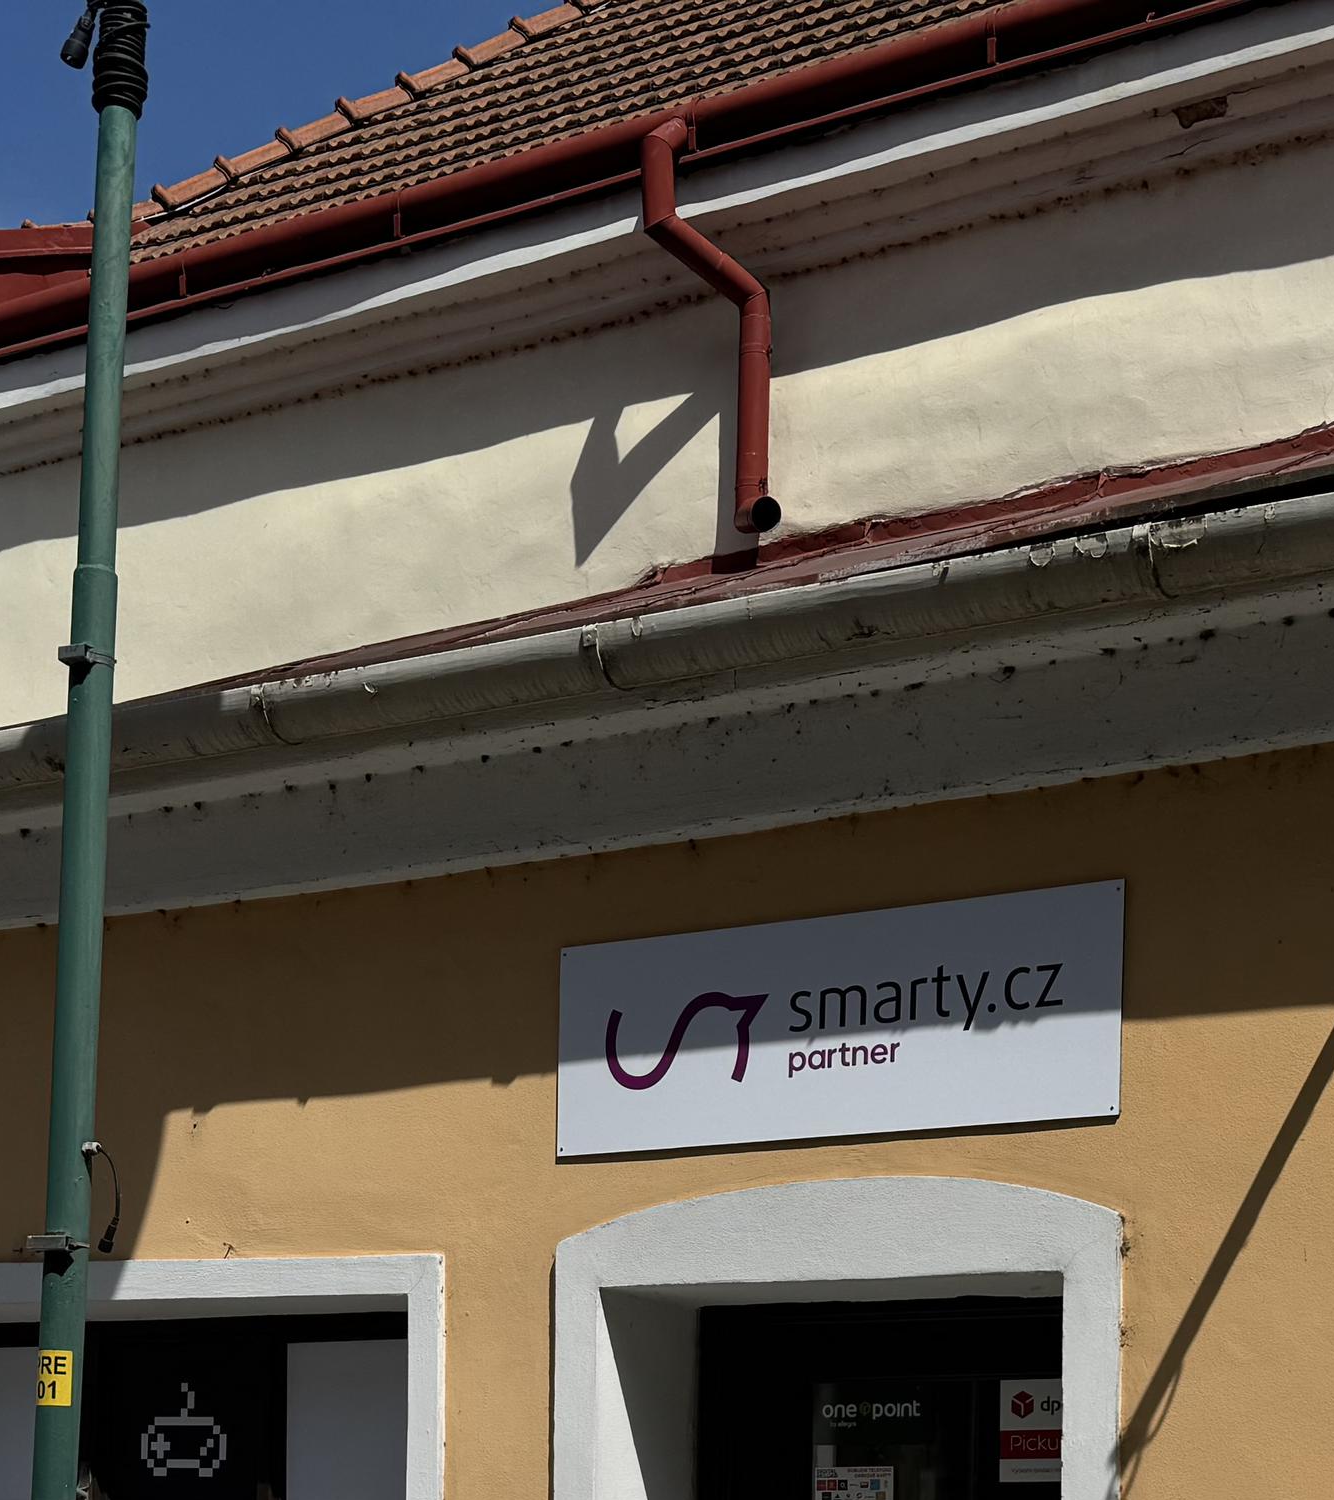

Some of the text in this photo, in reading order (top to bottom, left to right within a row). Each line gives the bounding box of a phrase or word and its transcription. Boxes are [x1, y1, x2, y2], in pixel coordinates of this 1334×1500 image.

[787, 962, 1065, 1033] smarty.cz
[787, 1038, 901, 1078] partner
[822, 1400, 921, 1420] one point
[1040, 1395, 1063, 1416] dp
